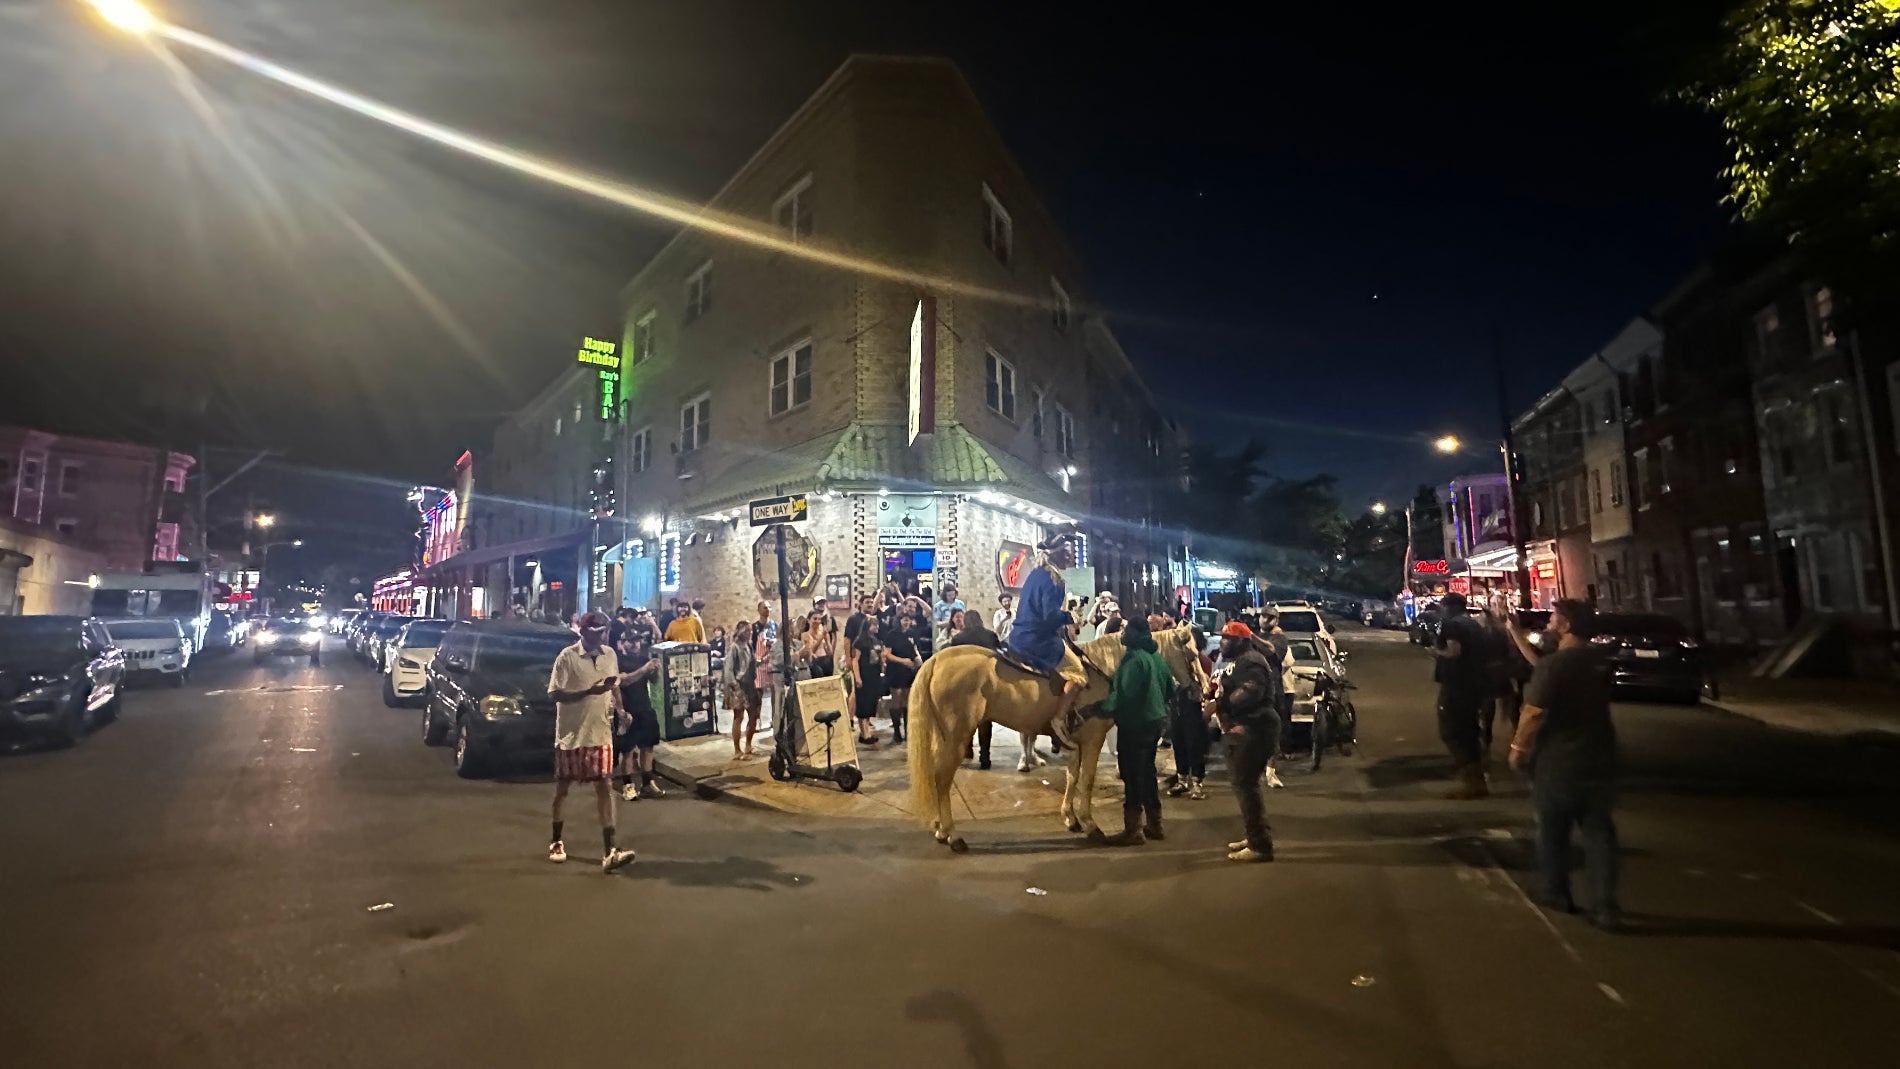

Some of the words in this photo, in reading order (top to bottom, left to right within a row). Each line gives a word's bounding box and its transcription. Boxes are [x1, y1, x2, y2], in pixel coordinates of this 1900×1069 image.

[583, 336, 615, 354] Happy
[578, 349, 619, 368] Birthday
[754, 506, 770, 519] ONE
[772, 503, 789, 516] WAY
[1451, 582, 1468, 590] STOP
